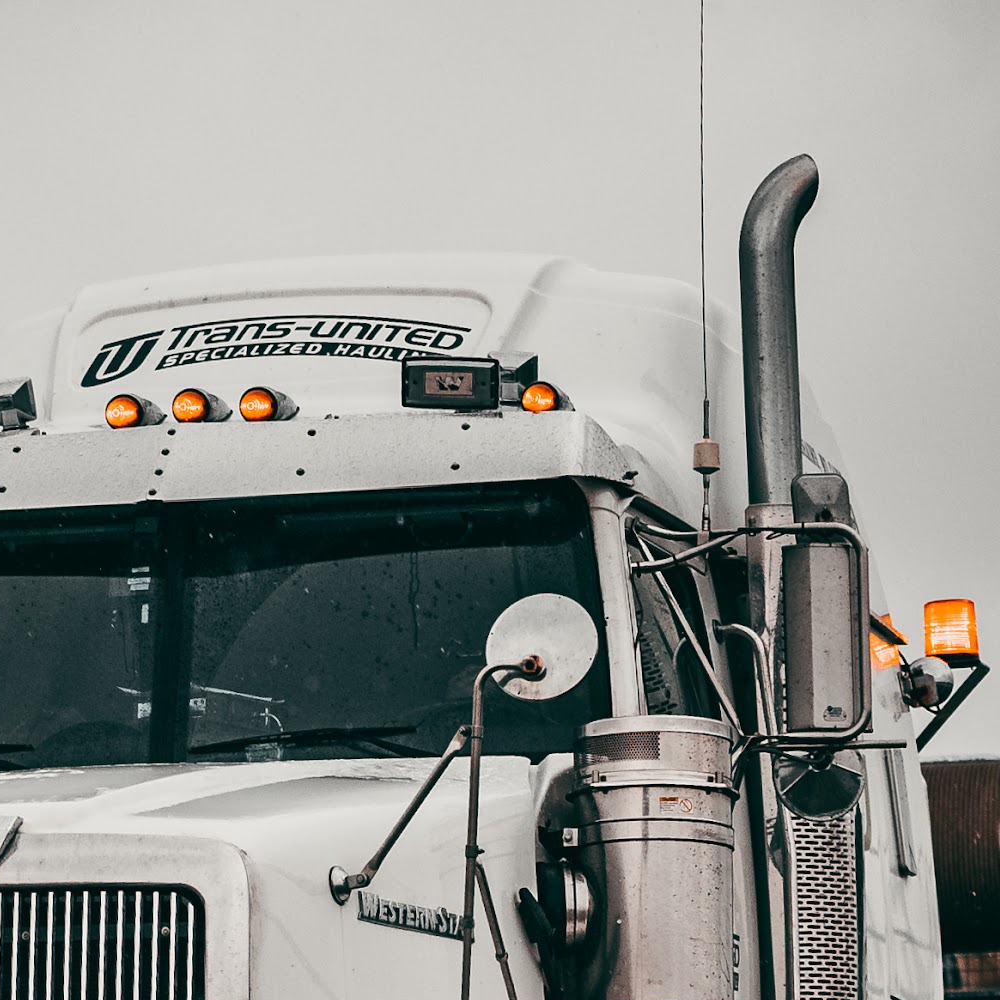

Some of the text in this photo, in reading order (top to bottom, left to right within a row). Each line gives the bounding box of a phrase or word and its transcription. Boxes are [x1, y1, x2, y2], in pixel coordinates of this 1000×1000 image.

[162, 343, 323, 368] SPECIALIZED
[359, 890, 474, 940] WESTERN STA
